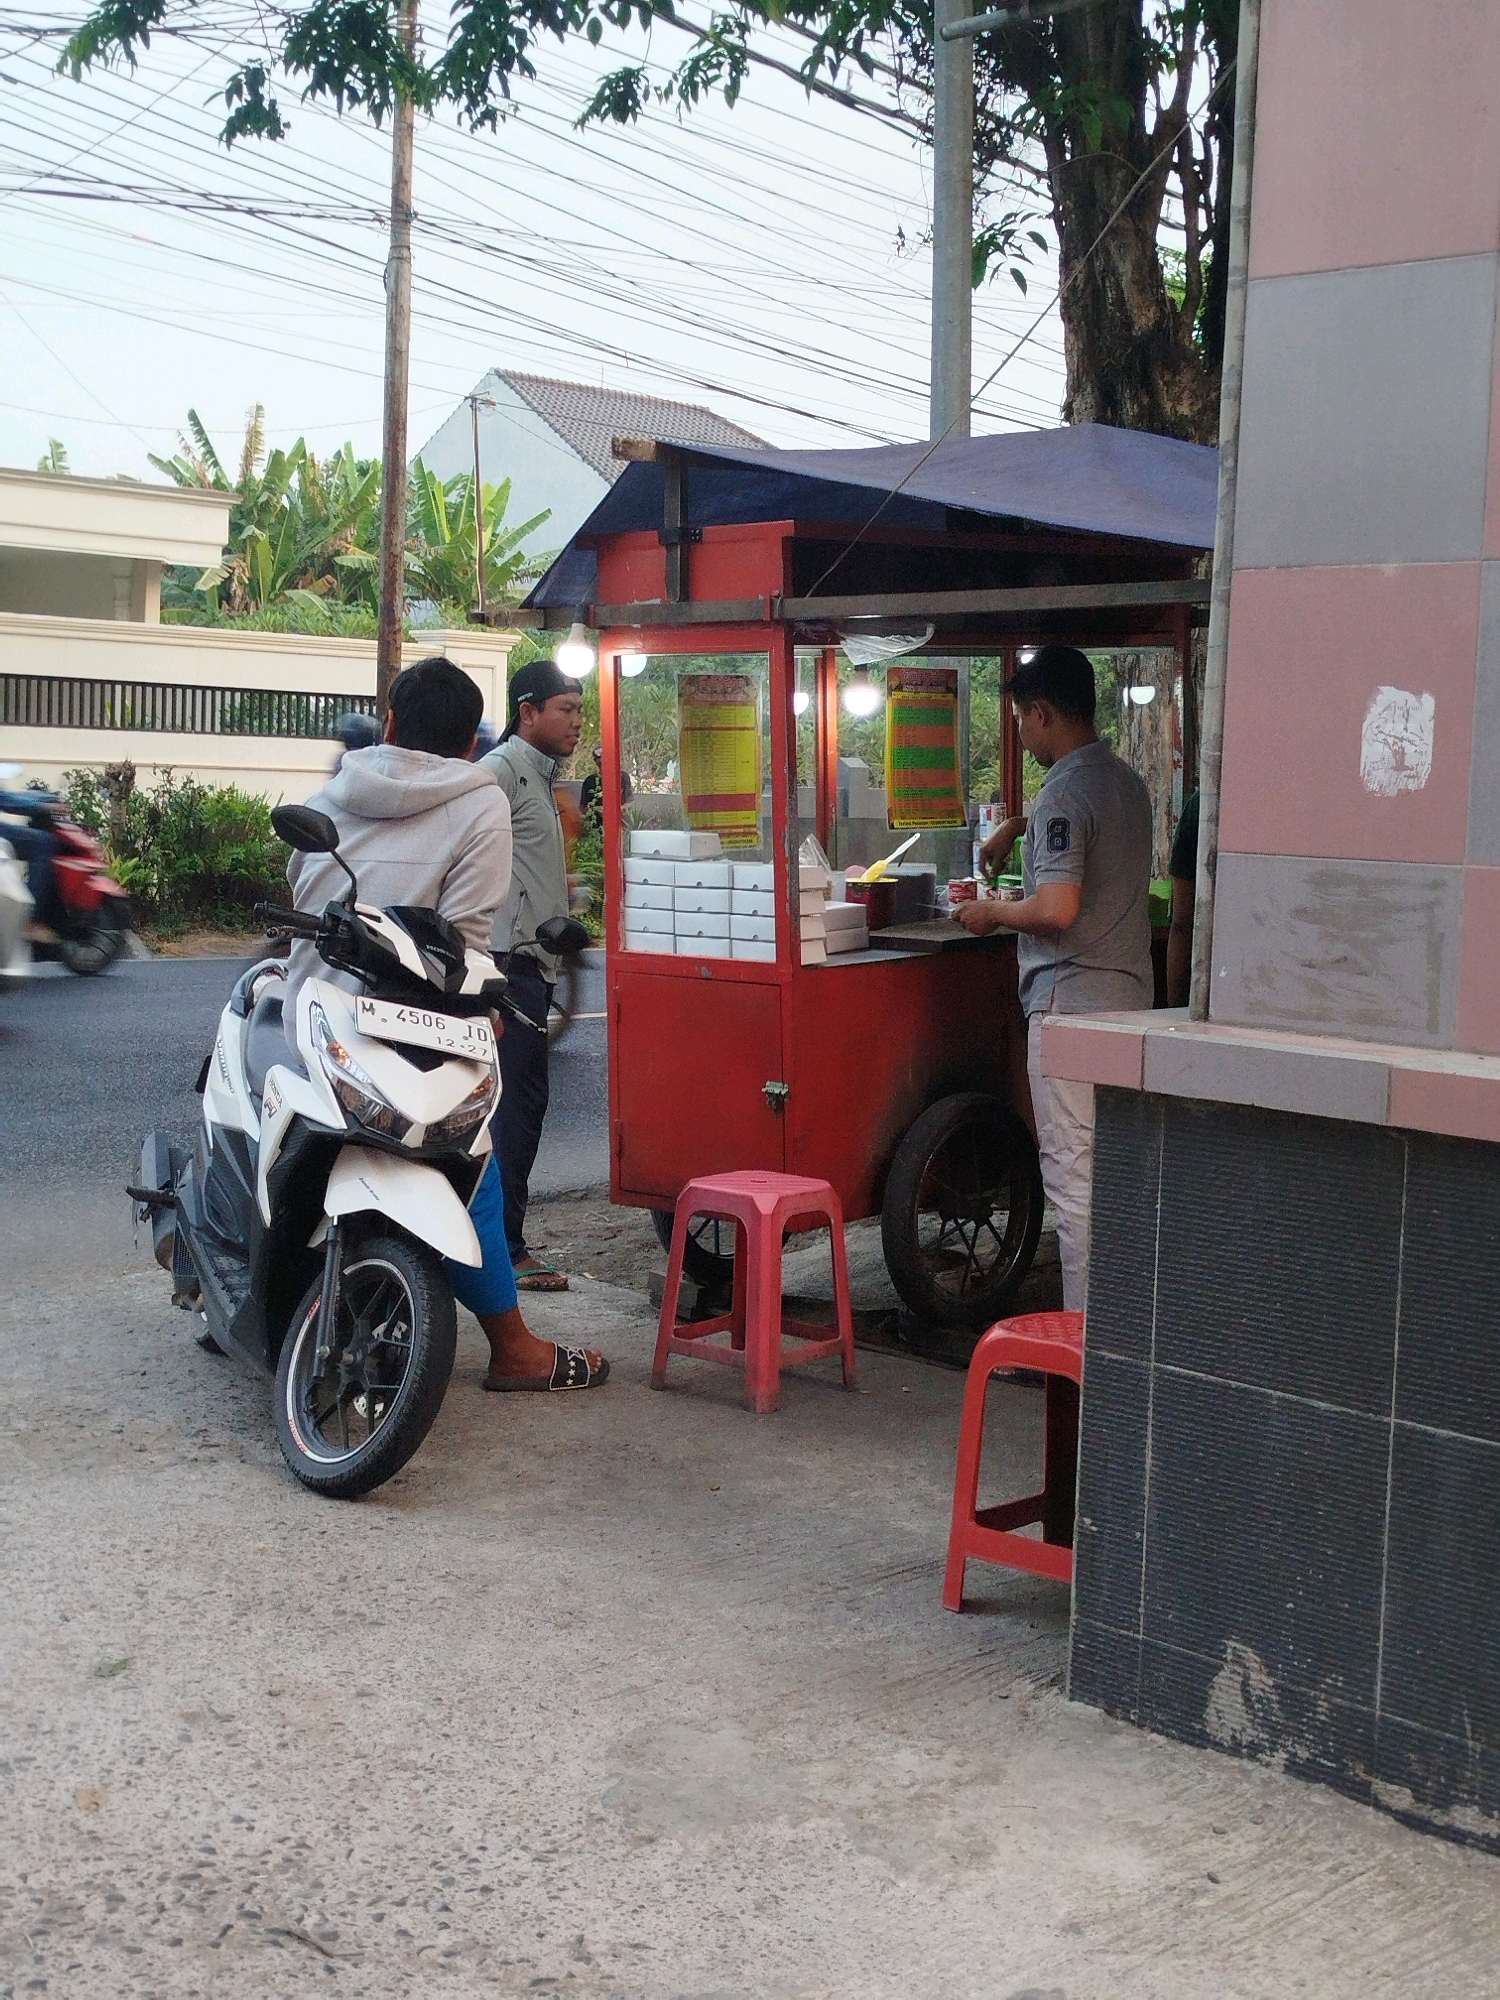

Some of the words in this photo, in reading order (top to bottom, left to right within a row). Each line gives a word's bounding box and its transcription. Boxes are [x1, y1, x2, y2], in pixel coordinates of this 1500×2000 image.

[1047, 817, 1071, 854] 8
[361, 1000, 376, 1016] M
[396, 1008, 446, 1030] 4506
[466, 1024, 488, 1042] ID
[268, 1076, 283, 1108] HONDA
